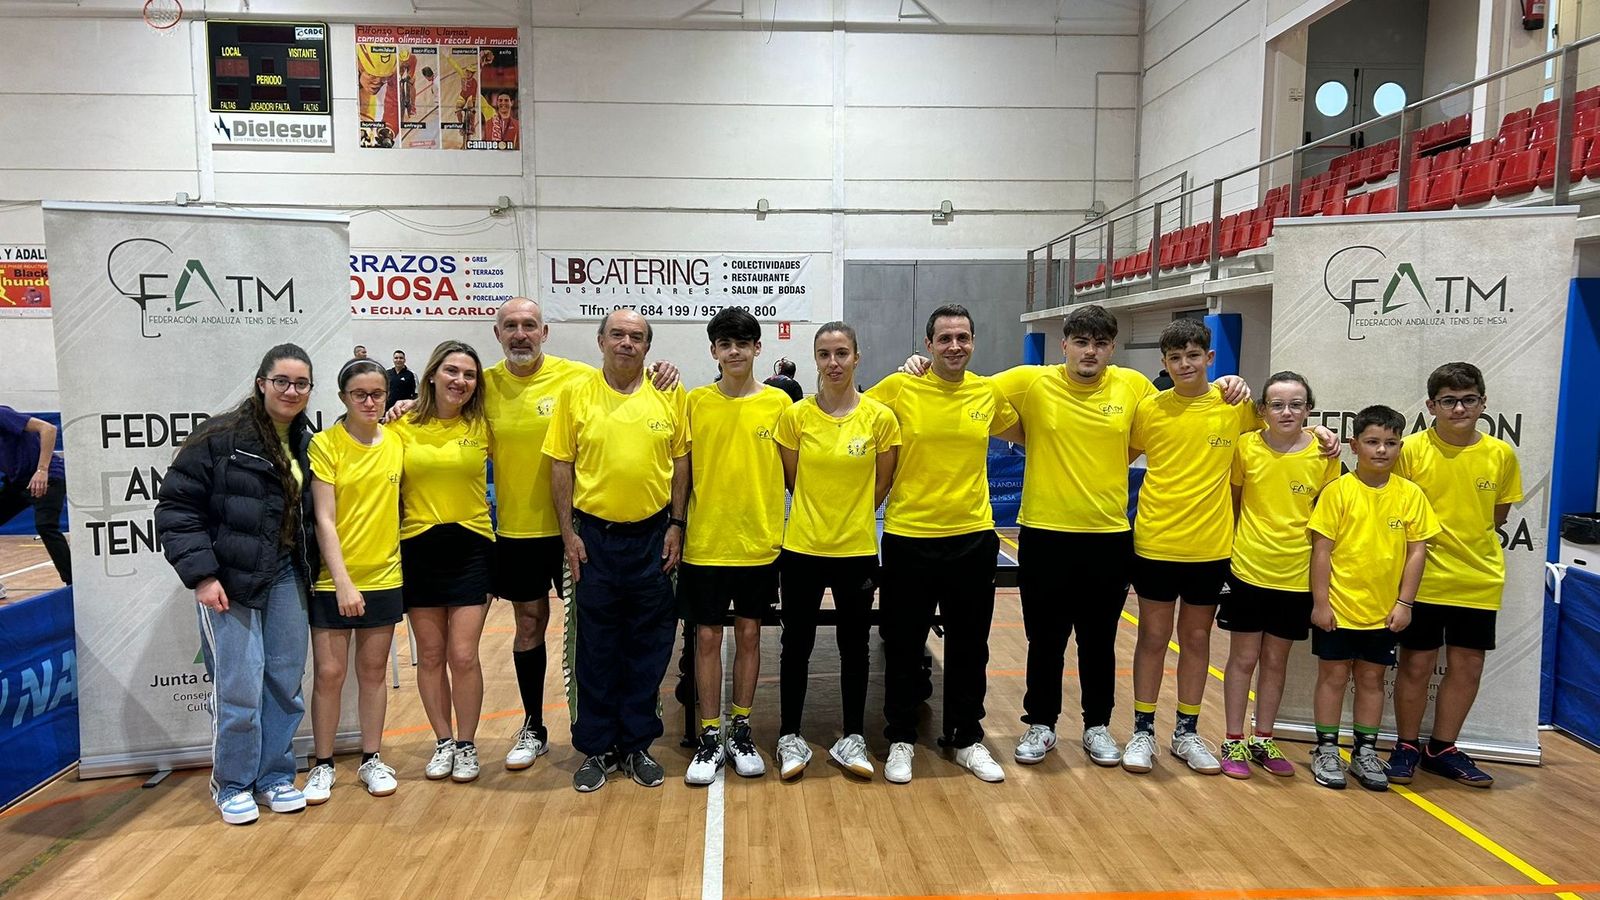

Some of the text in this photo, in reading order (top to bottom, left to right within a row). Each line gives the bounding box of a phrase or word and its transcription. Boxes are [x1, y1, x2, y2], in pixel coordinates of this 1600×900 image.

[357, 24, 469, 37] Alfonso Cabello Llamas
[357, 34, 518, 46] campeón olímpico y récord del mundo
[221, 46, 242, 57] LOCAL
[287, 48, 317, 58] VISITANTE
[256, 75, 283, 85] PERIODO
[220, 101, 237, 110] FALTAS
[275, 103, 291, 111] FALTA
[303, 103, 319, 111] FALTAS
[233, 120, 327, 138] Dielesur
[4, 248, 12, 260] Y
[350, 254, 457, 274] RRAZOS
[731, 260, 801, 270] COLECTIVIDADES
[14, 269, 49, 278] Black
[551, 257, 710, 286] LBCATERING
[731, 273, 790, 282] RESTAURANTE
[731, 285, 806, 295] SALON DE BODAS
[370, 306, 413, 316] ECIJA
[425, 306, 444, 315] LA
[580, 304, 609, 316] Tlfn:
[640, 304, 664, 316] 684
[667, 304, 690, 316] 199
[754, 305, 777, 317] 800
[149, 315, 299, 325] FEDERACIÓN ANDALUZA TENIS DE MESA
[1405, 317, 1446, 326] ANDALUZA
[1450, 317, 1470, 326] TENIS
[1473, 317, 1484, 325] DE
[1487, 317, 1508, 325] MESA
[85, 519, 162, 556] TENI
[150, 672, 198, 688] Junta
[173, 691, 213, 703] Conseje
[187, 702, 208, 712] Cult
